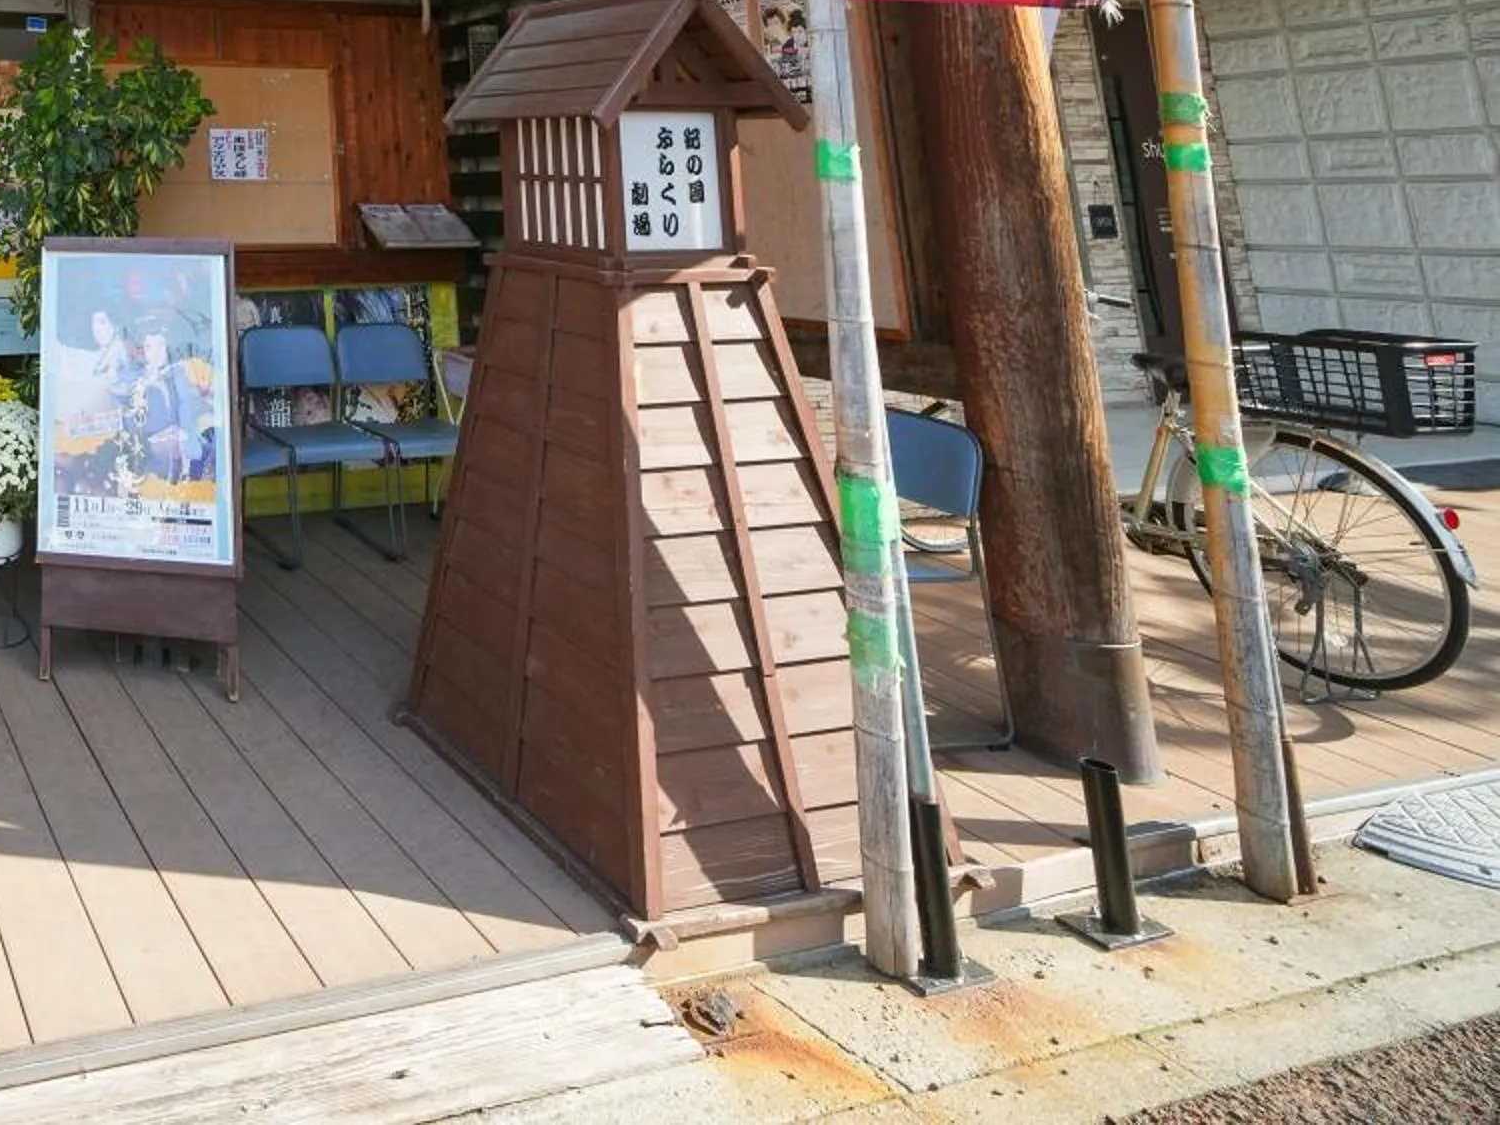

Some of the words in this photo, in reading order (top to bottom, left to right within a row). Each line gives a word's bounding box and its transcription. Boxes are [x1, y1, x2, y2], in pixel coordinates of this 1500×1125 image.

[656, 126, 680, 238] ぶらくり
[684, 127, 705, 204] 紀の国
[631, 181, 651, 236] 劇場
